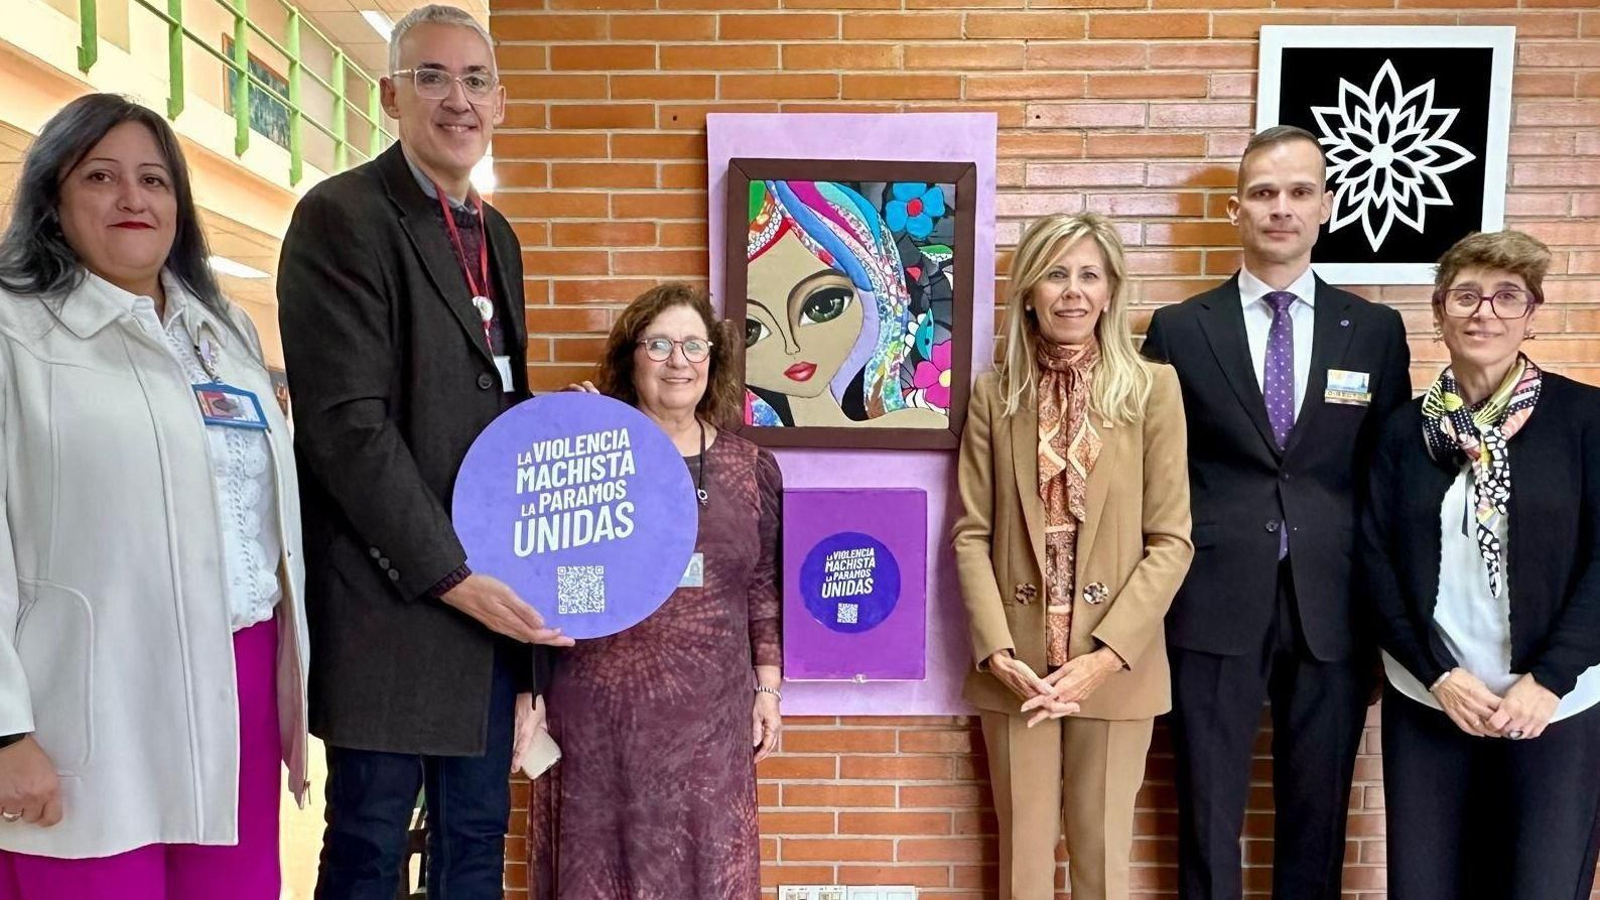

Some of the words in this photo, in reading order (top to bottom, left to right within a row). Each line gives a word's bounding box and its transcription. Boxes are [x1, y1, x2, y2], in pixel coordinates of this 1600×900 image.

[517, 451, 532, 466] LA
[533, 427, 631, 463] VIOLENCIA
[516, 449, 636, 494] MACHISTA
[521, 503, 536, 517] LA
[539, 479, 627, 514] PARAMOS
[513, 501, 635, 557] UNIDAS
[825, 557, 875, 573] MACHISTA
[833, 548, 874, 560] VIOLENCIA
[822, 578, 873, 598] UNIDAS
[833, 568, 872, 581] PARAMOS
